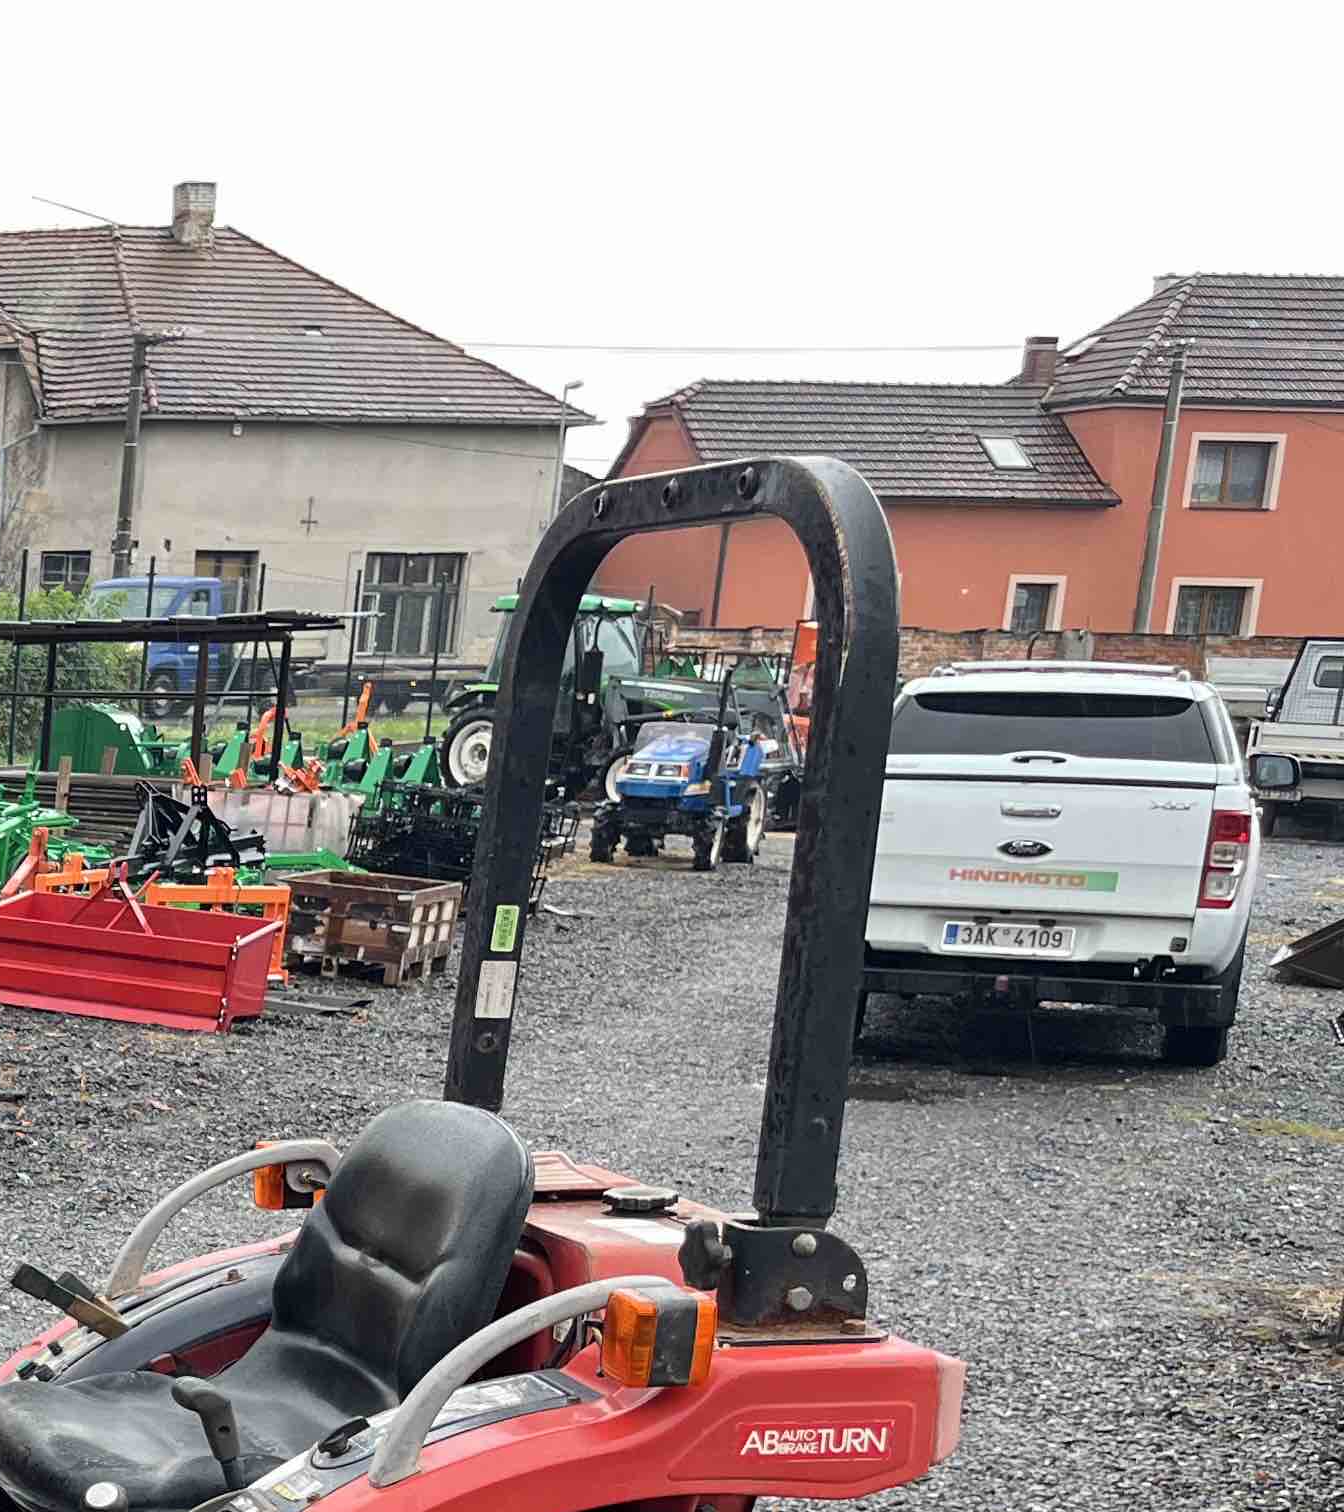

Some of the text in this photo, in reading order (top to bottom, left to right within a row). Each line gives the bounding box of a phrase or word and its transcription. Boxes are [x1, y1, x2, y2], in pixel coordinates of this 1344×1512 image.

[948, 867, 1088, 888] HINOMOTO
[962, 926, 1063, 949] 3AK 4109
[740, 1430, 779, 1456] AB
[817, 1427, 888, 1454] TURN
